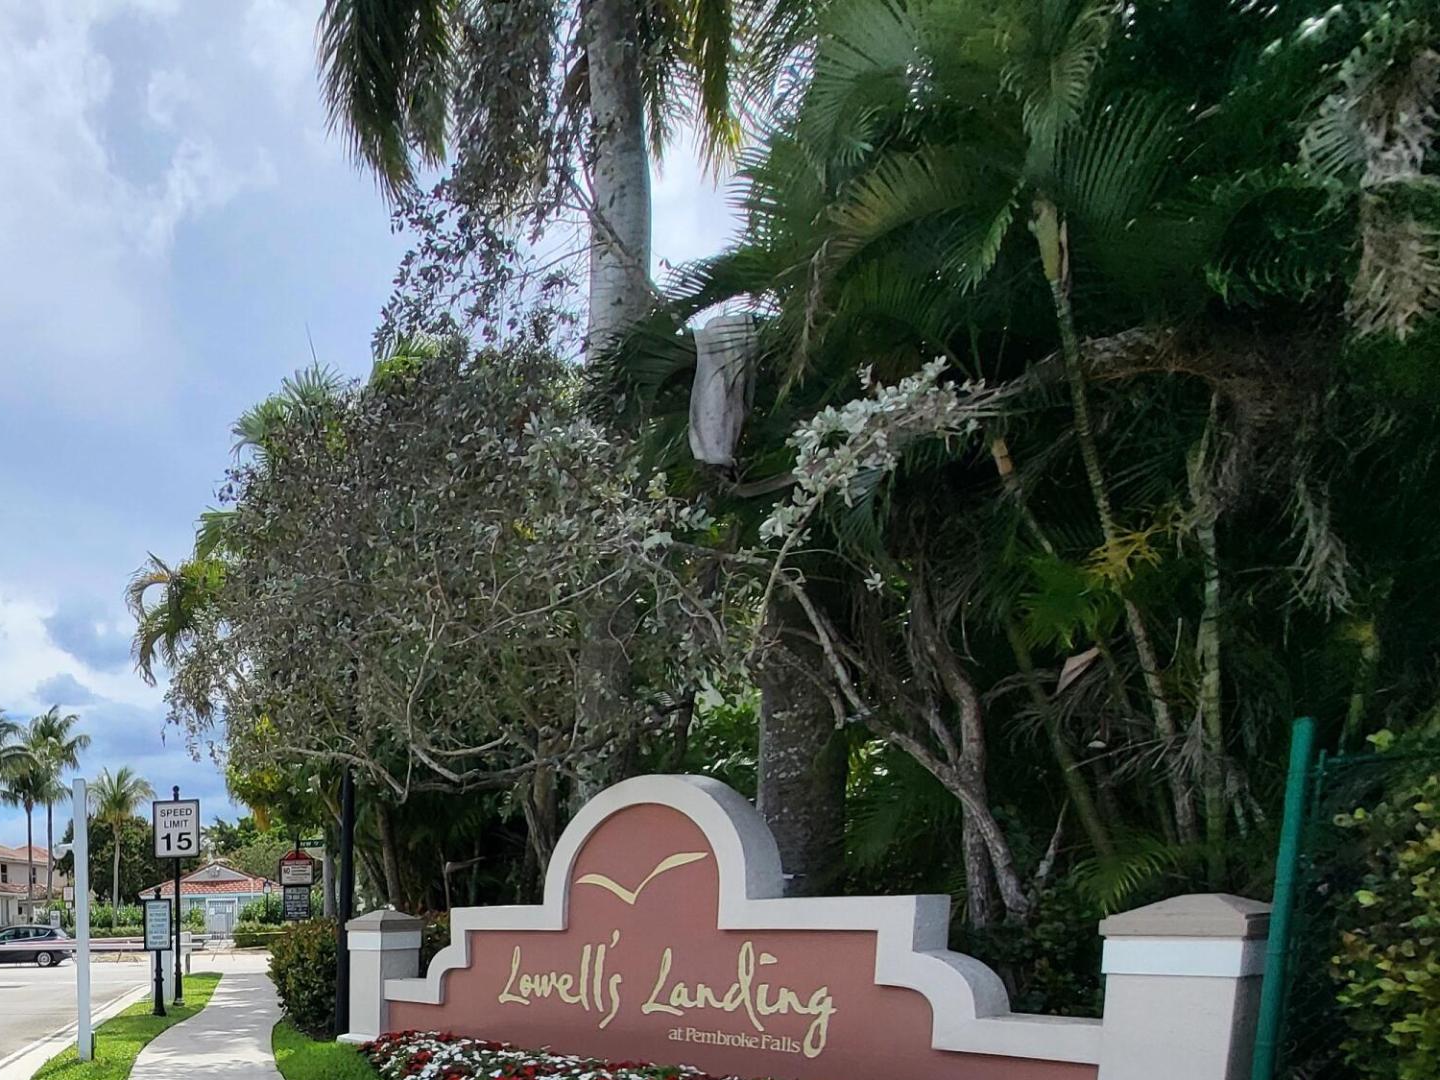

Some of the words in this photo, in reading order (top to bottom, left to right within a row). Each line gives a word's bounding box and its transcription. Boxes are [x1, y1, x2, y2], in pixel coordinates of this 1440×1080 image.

[160, 808, 192, 817] SPEED
[164, 820, 189, 828] LIMIT
[161, 832, 192, 851] 15
[498, 929, 622, 1029] Lowell's
[641, 941, 837, 1058] Landing
[668, 1028, 685, 1041] at
[686, 1027, 759, 1049] Pembroke
[761, 1034, 801, 1053] Falls
